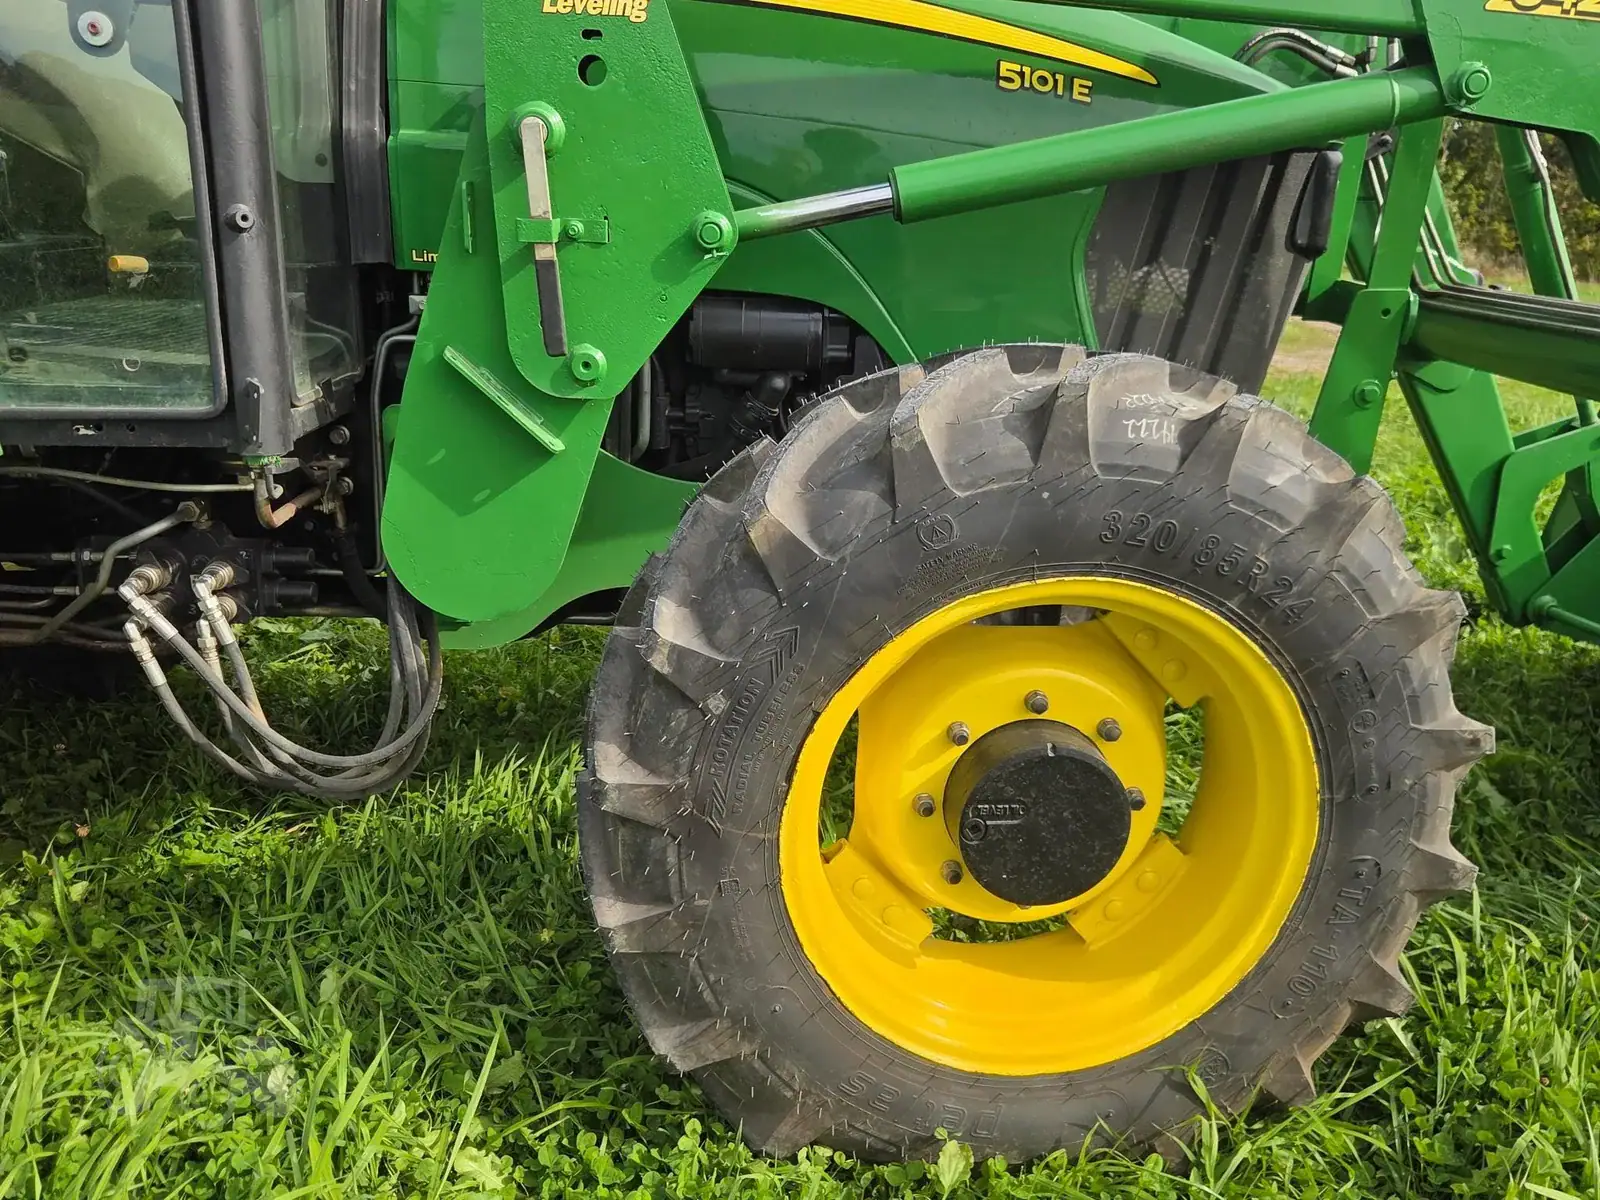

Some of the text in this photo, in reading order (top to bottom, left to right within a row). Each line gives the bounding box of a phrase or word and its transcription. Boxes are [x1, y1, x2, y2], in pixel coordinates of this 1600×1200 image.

[541, 0, 648, 23] Leveling
[997, 60, 1094, 104] 5101 E
[708, 676, 765, 779] ROTATION
[977, 804, 1009, 816] LEVEL
